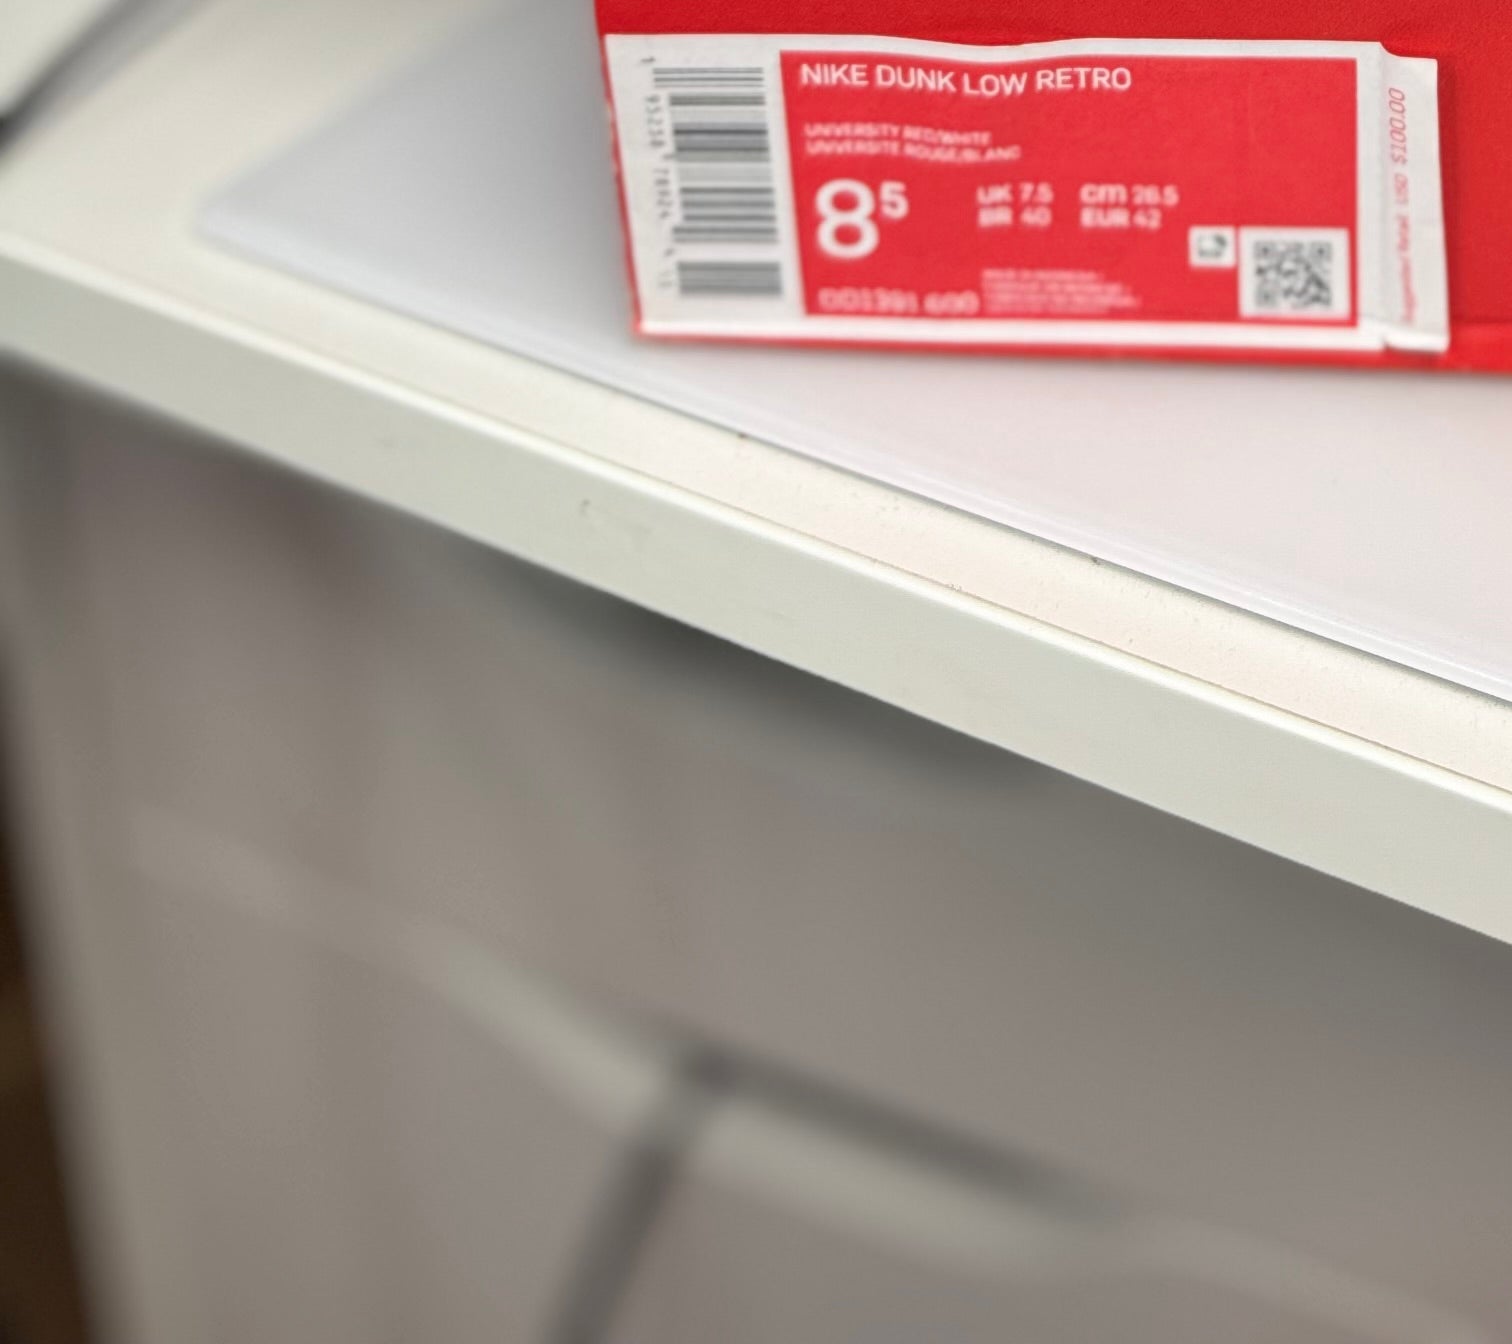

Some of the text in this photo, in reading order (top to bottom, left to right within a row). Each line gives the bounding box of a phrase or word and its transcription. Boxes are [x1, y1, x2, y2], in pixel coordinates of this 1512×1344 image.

[800, 62, 1132, 97] NIKE DUNK LOW RETRO
[803, 122, 899, 139] UNIVERSITY
[1387, 86, 1408, 166] $100.00
[976, 181, 1179, 207] UK 7.5 cm 26.5
[1020, 206, 1053, 227] 40
[1079, 206, 1130, 229] EUR
